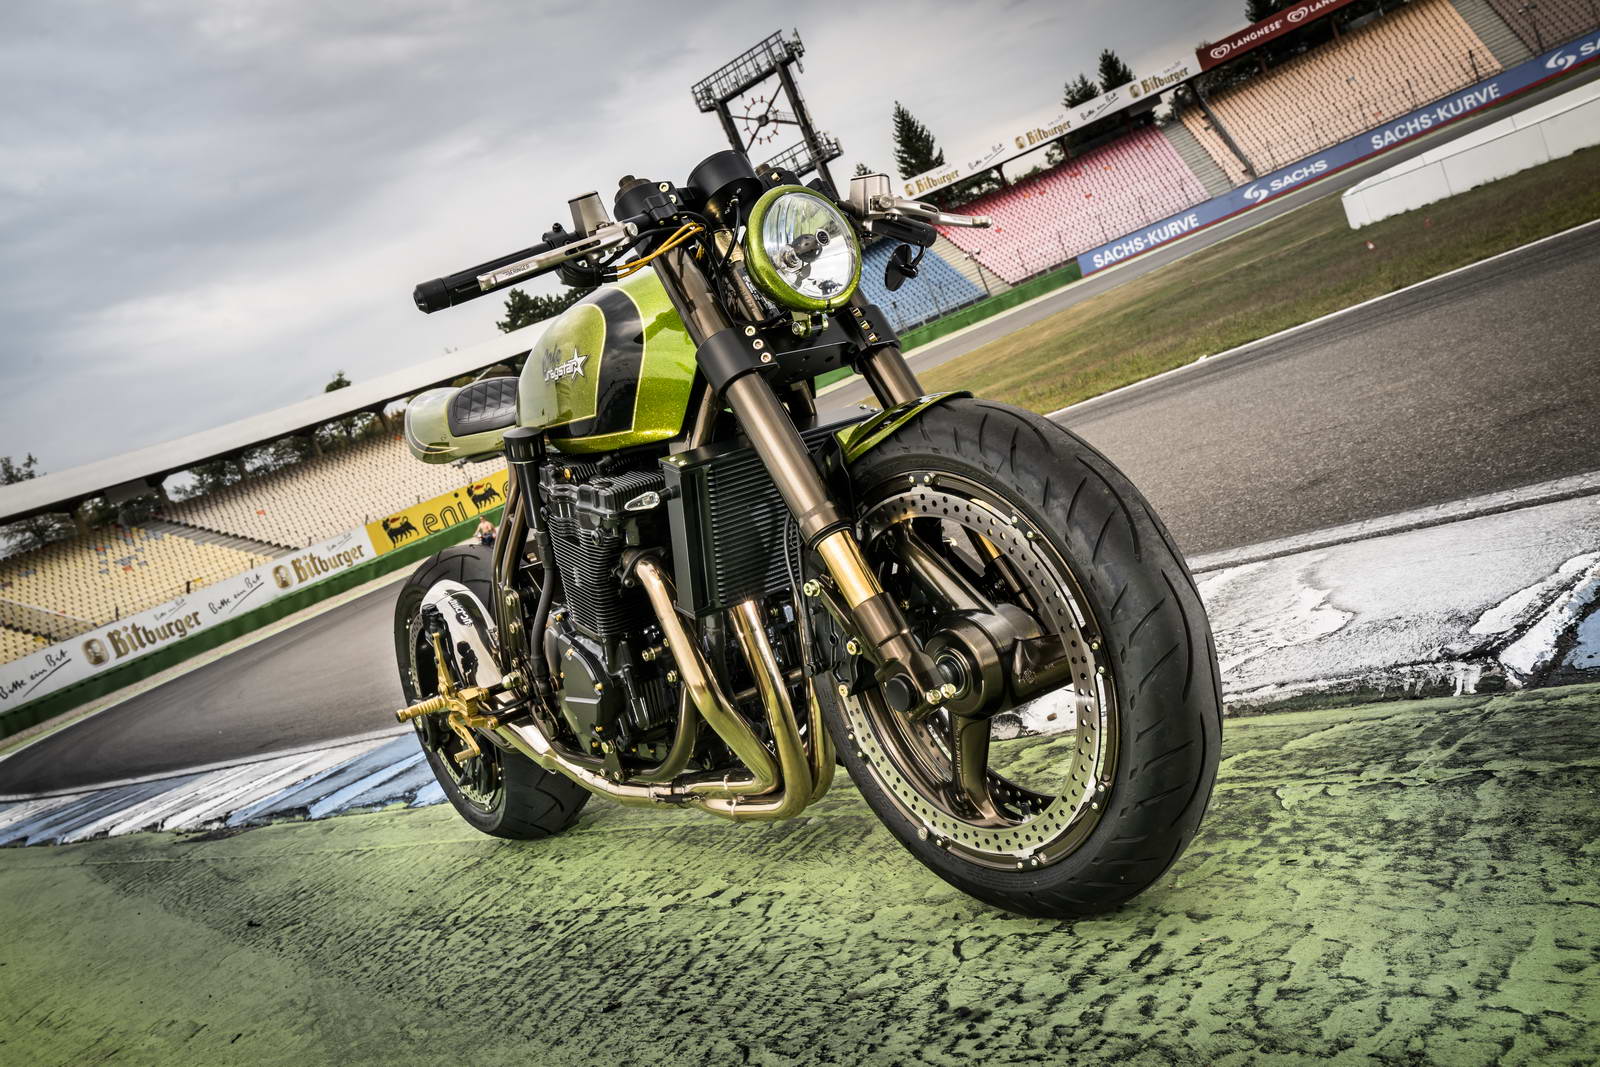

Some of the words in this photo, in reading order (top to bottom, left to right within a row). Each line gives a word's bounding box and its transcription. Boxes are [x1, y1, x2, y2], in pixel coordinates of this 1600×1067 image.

[1309, 0, 1337, 12] LAN
[1231, 20, 1280, 49] LANGNESE
[1140, 67, 1188, 94] Bitburger
[1025, 120, 1071, 145] Bitburger
[1371, 83, 1501, 150] SACHS-KURVE
[915, 170, 960, 194] Bitburger
[1270, 159, 1328, 192] SACHS
[1093, 213, 1199, 268] SACHS-KURVE
[422, 492, 468, 535] eni
[290, 544, 365, 584] Bitburger
[106, 611, 201, 659] Bitburger
[0, 680, 26, 699] Bitte
[30, 669, 47, 680] ein
[45, 649, 67, 667] Bit
